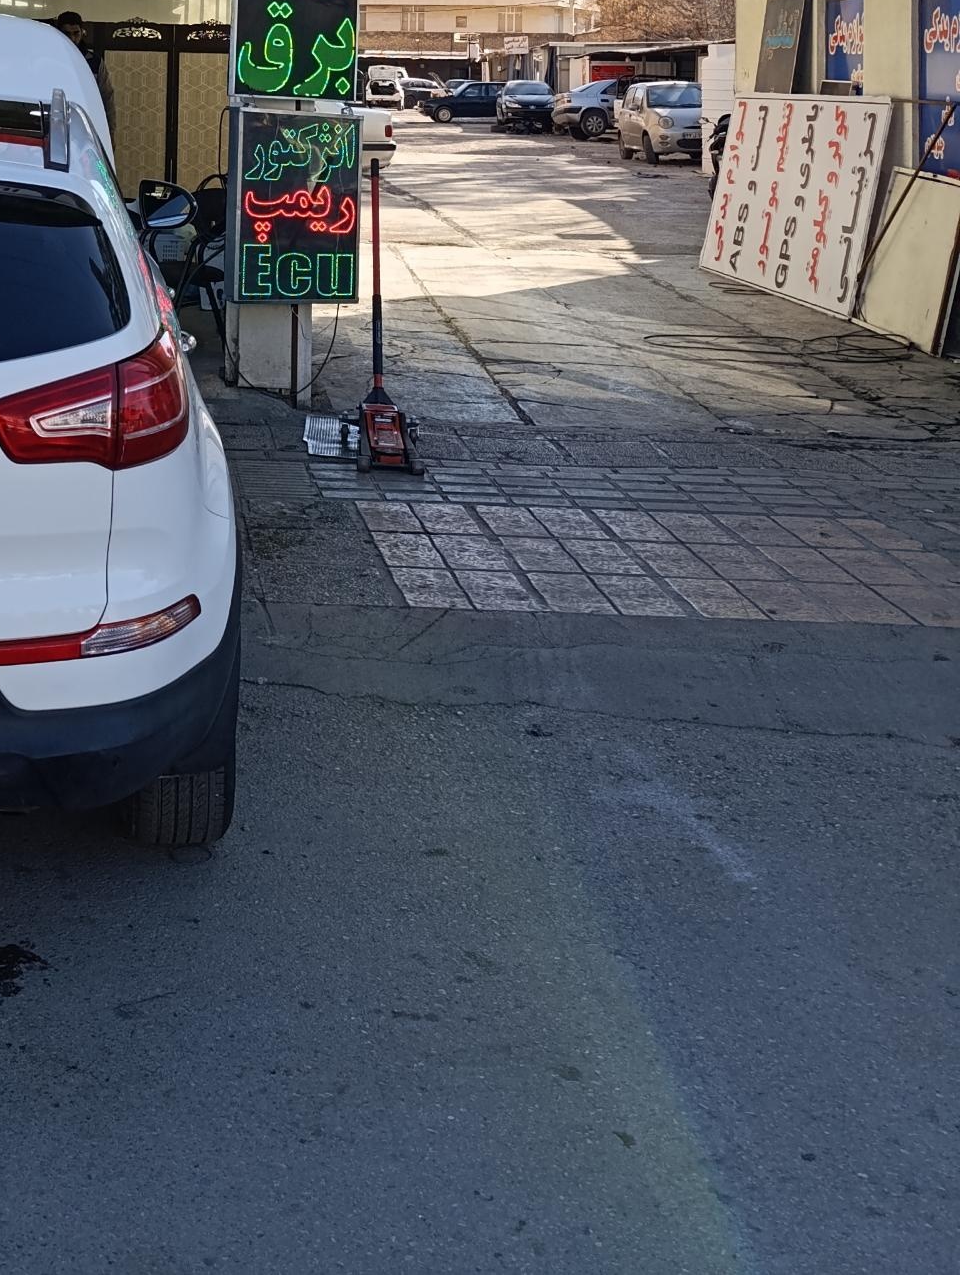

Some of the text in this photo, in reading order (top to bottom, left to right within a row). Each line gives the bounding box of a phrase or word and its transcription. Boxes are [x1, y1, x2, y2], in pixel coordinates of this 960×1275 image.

[238, 1, 355, 96] برق
[245, 123, 356, 183] انژکتور
[245, 185, 356, 243] ریمپ
[729, 203, 750, 273] ABS
[774, 216, 798, 288] GPS
